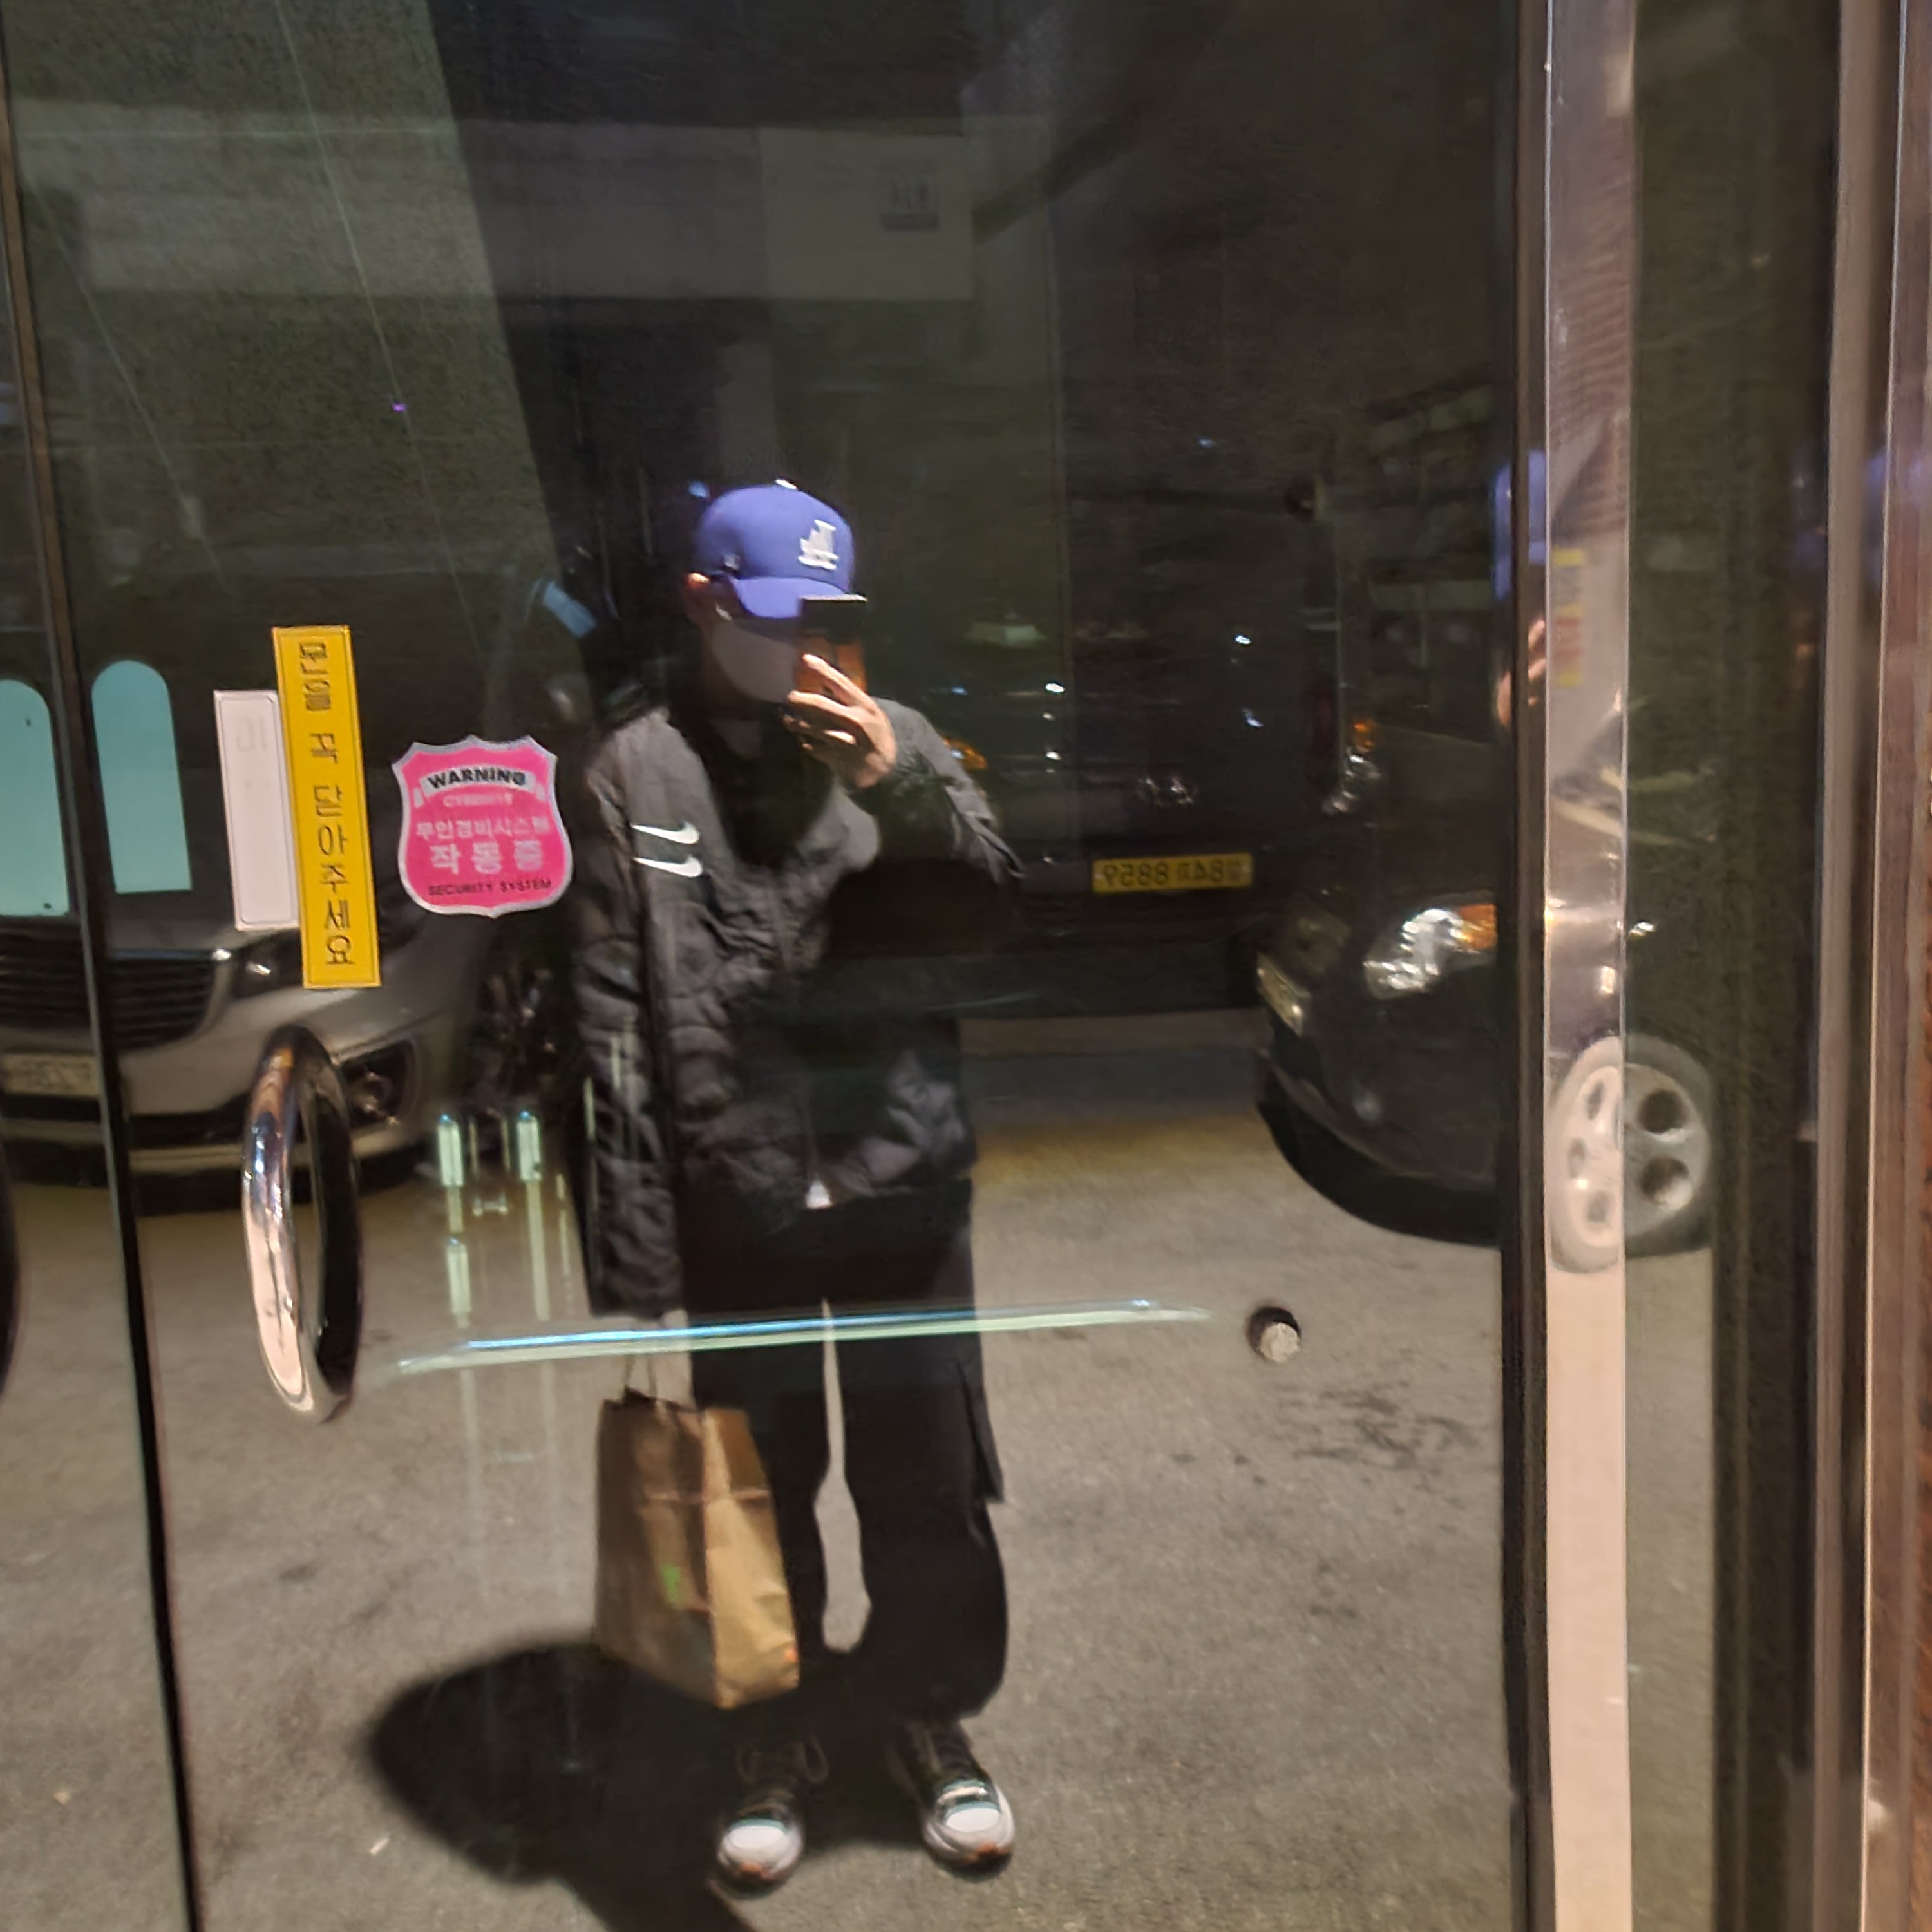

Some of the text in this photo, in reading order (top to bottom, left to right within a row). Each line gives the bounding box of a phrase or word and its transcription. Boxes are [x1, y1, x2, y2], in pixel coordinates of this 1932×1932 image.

[427, 767, 526, 789] WARNING
[428, 878, 552, 896] SECURITY SYSTEM
